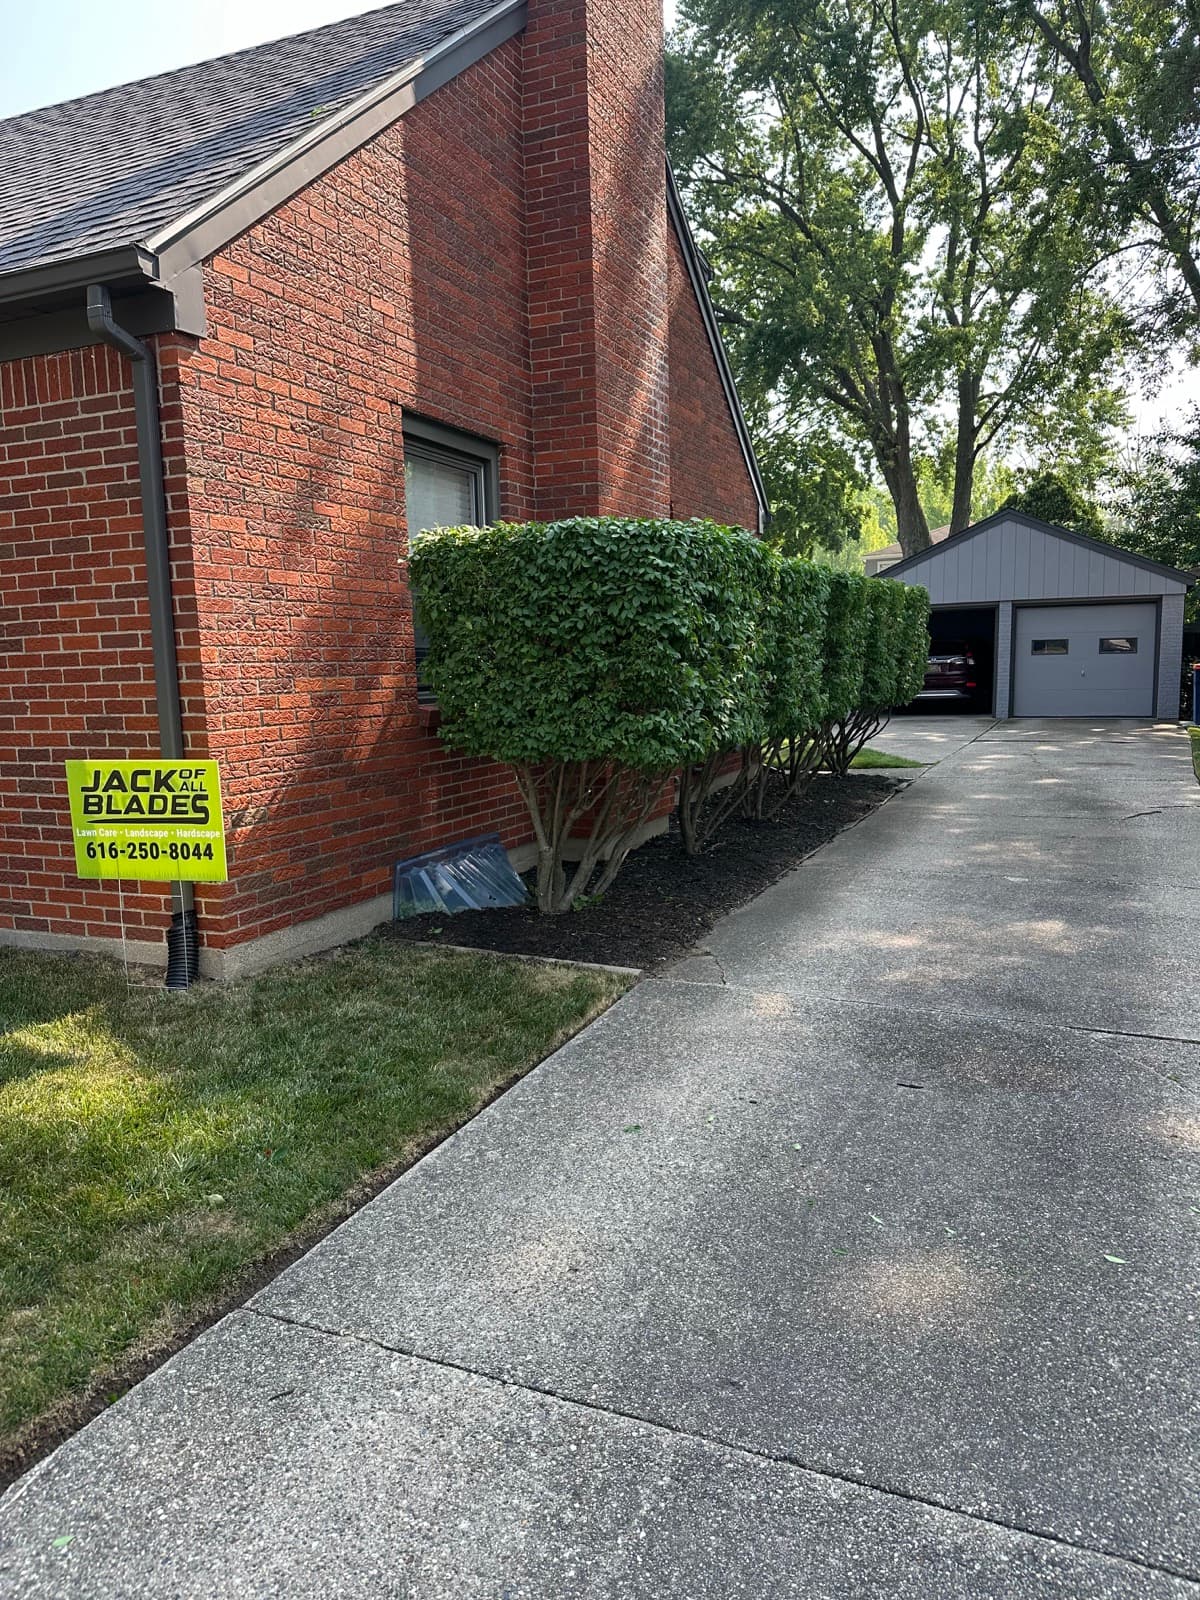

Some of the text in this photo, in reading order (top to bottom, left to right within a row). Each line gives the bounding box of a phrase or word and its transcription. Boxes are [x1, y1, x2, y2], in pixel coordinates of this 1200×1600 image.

[81, 769, 207, 793] JACK OF
[179, 781, 207, 792] ALL
[83, 794, 210, 824] BLADES
[76, 828, 221, 839] Lawn Care Landscape Hardscape
[86, 841, 214, 860] 616-250-8044
